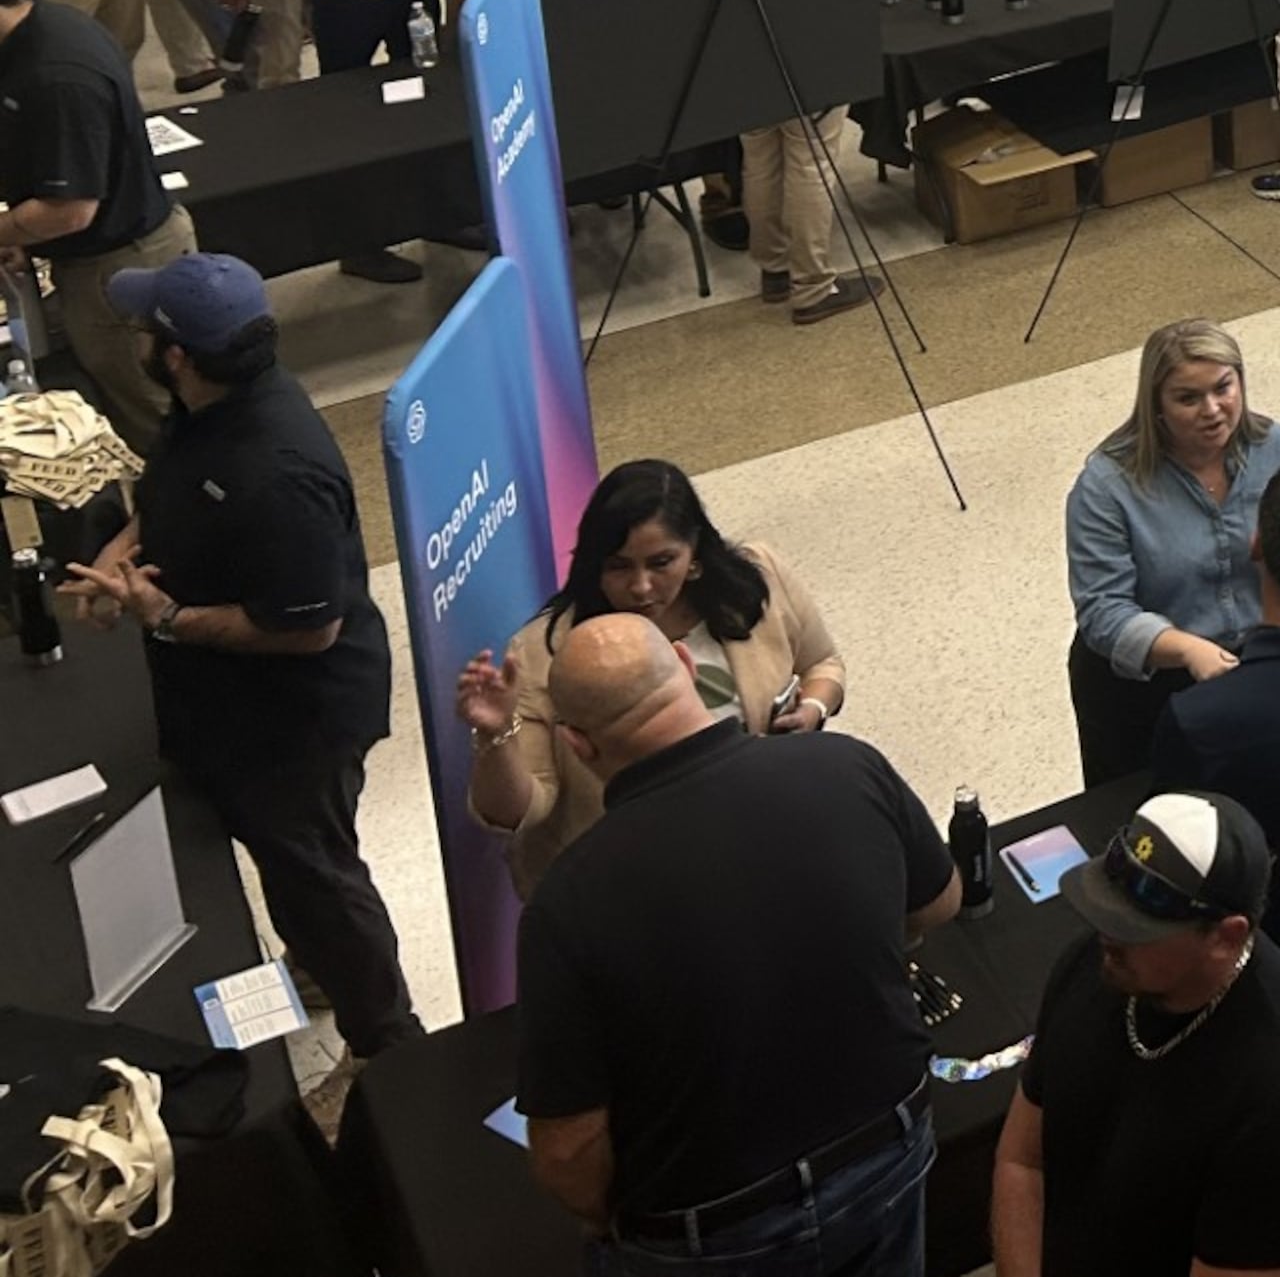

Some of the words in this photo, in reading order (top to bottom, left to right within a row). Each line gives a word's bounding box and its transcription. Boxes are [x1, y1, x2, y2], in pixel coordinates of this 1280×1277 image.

[491, 77, 524, 143] OpenAI
[497, 110, 535, 184] Academy
[31, 462, 78, 476] FEED
[427, 458, 489, 569] OpenAI
[433, 480, 517, 623] Recruiting
